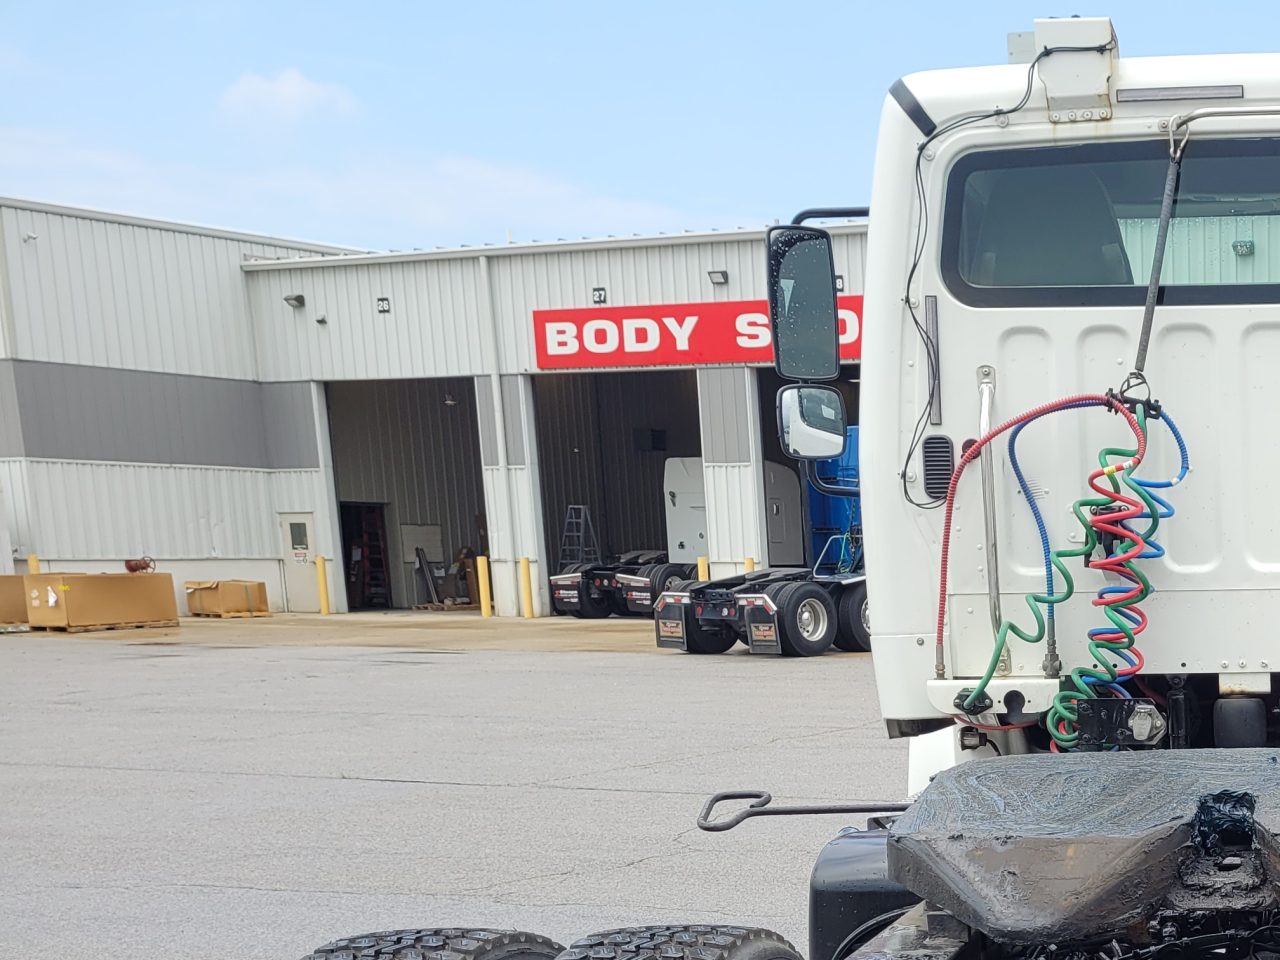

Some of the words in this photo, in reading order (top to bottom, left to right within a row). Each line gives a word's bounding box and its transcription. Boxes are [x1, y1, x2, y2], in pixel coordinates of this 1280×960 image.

[593, 291, 606, 302] 27
[378, 301, 389, 312] 26
[545, 316, 698, 355] BODY
